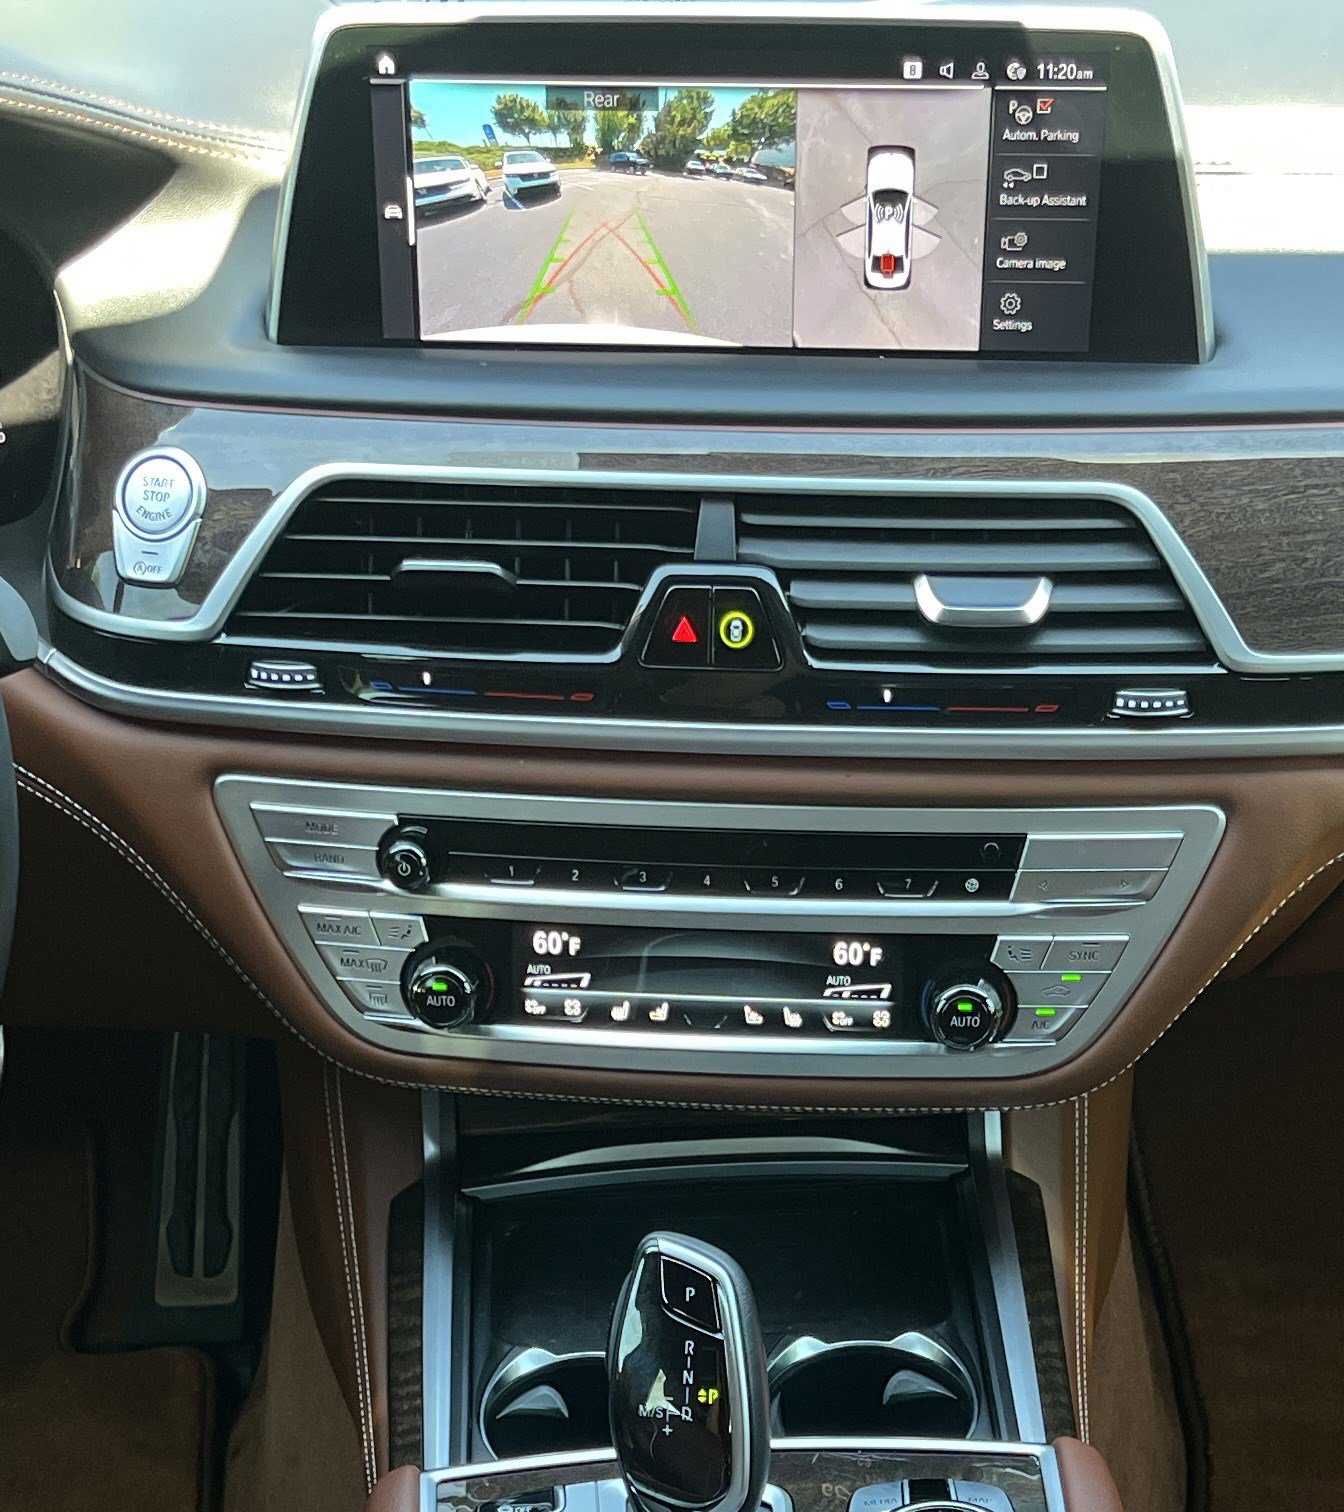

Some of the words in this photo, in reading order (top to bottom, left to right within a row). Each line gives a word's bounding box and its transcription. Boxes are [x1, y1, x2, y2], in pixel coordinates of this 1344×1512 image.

[582, 89, 621, 108] Rear
[1002, 129, 1039, 142] Autom.
[1040, 129, 1080, 143] Parking
[998, 193, 1040, 208] Back-up
[1042, 194, 1087, 207] Assistant
[996, 257, 1034, 270] Camera
[1035, 258, 1067, 271] image
[992, 319, 1033, 332] Settings
[142, 476, 176, 488] START
[142, 490, 171, 503] STOP
[136, 505, 173, 522] ENGINE
[145, 564, 163, 574] OFF
[509, 865, 516, 878] 1
[571, 869, 579, 882] 2
[638, 870, 647, 883] 3
[703, 874, 711, 887] 4
[771, 875, 779, 888] 5
[834, 878, 843, 891] 6
[904, 877, 913, 891] 7
[316, 922, 342, 934] MAX
[1068, 950, 1100, 961] SYNC
[340, 957, 365, 969] MAX
[526, 964, 552, 975] AUTO
[825, 975, 852, 986] AUTO
[426, 994, 457, 1008] AUTO
[949, 1015, 981, 1028] AUTO
[1030, 1019, 1051, 1030] A/C
[684, 1286, 696, 1302] P
[684, 1339, 695, 1355] R
[682, 1369, 694, 1385] N
